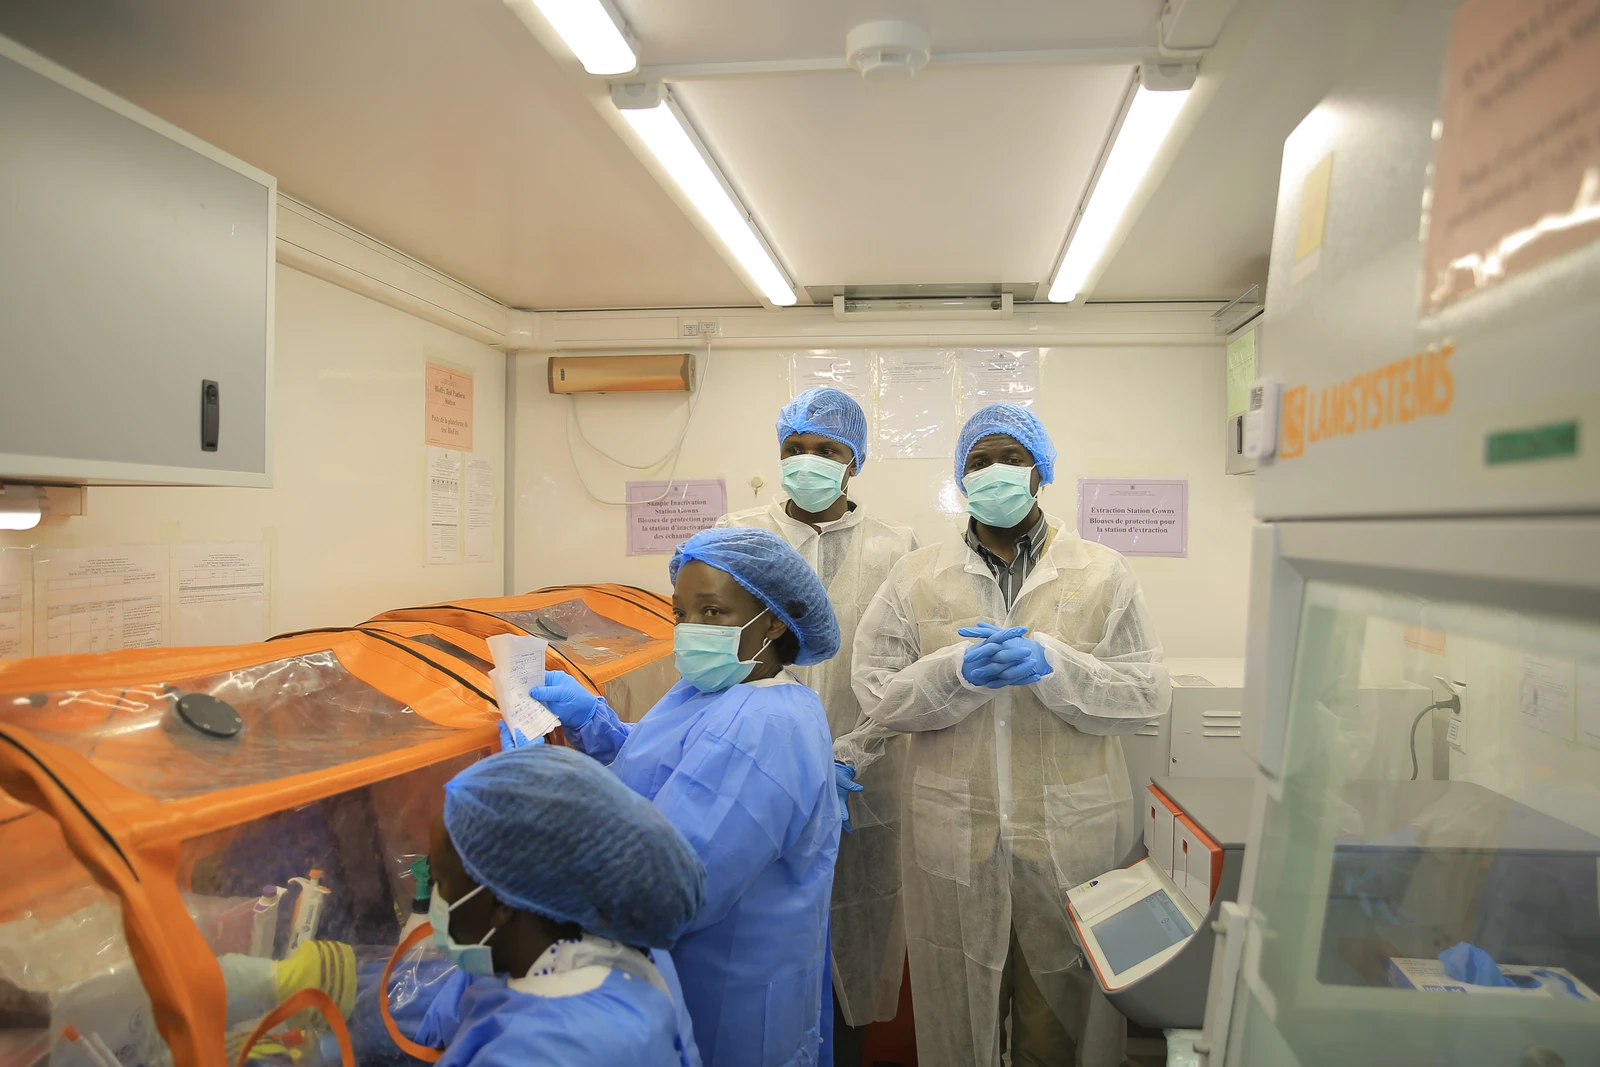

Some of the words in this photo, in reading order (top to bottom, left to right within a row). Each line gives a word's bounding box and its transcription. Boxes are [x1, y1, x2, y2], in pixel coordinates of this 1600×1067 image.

[1308, 345, 1455, 443] LAMSYSTEMS
[445, 398, 456, 406] Station
[670, 516, 701, 525] protection
[1125, 518, 1158, 526] protection
